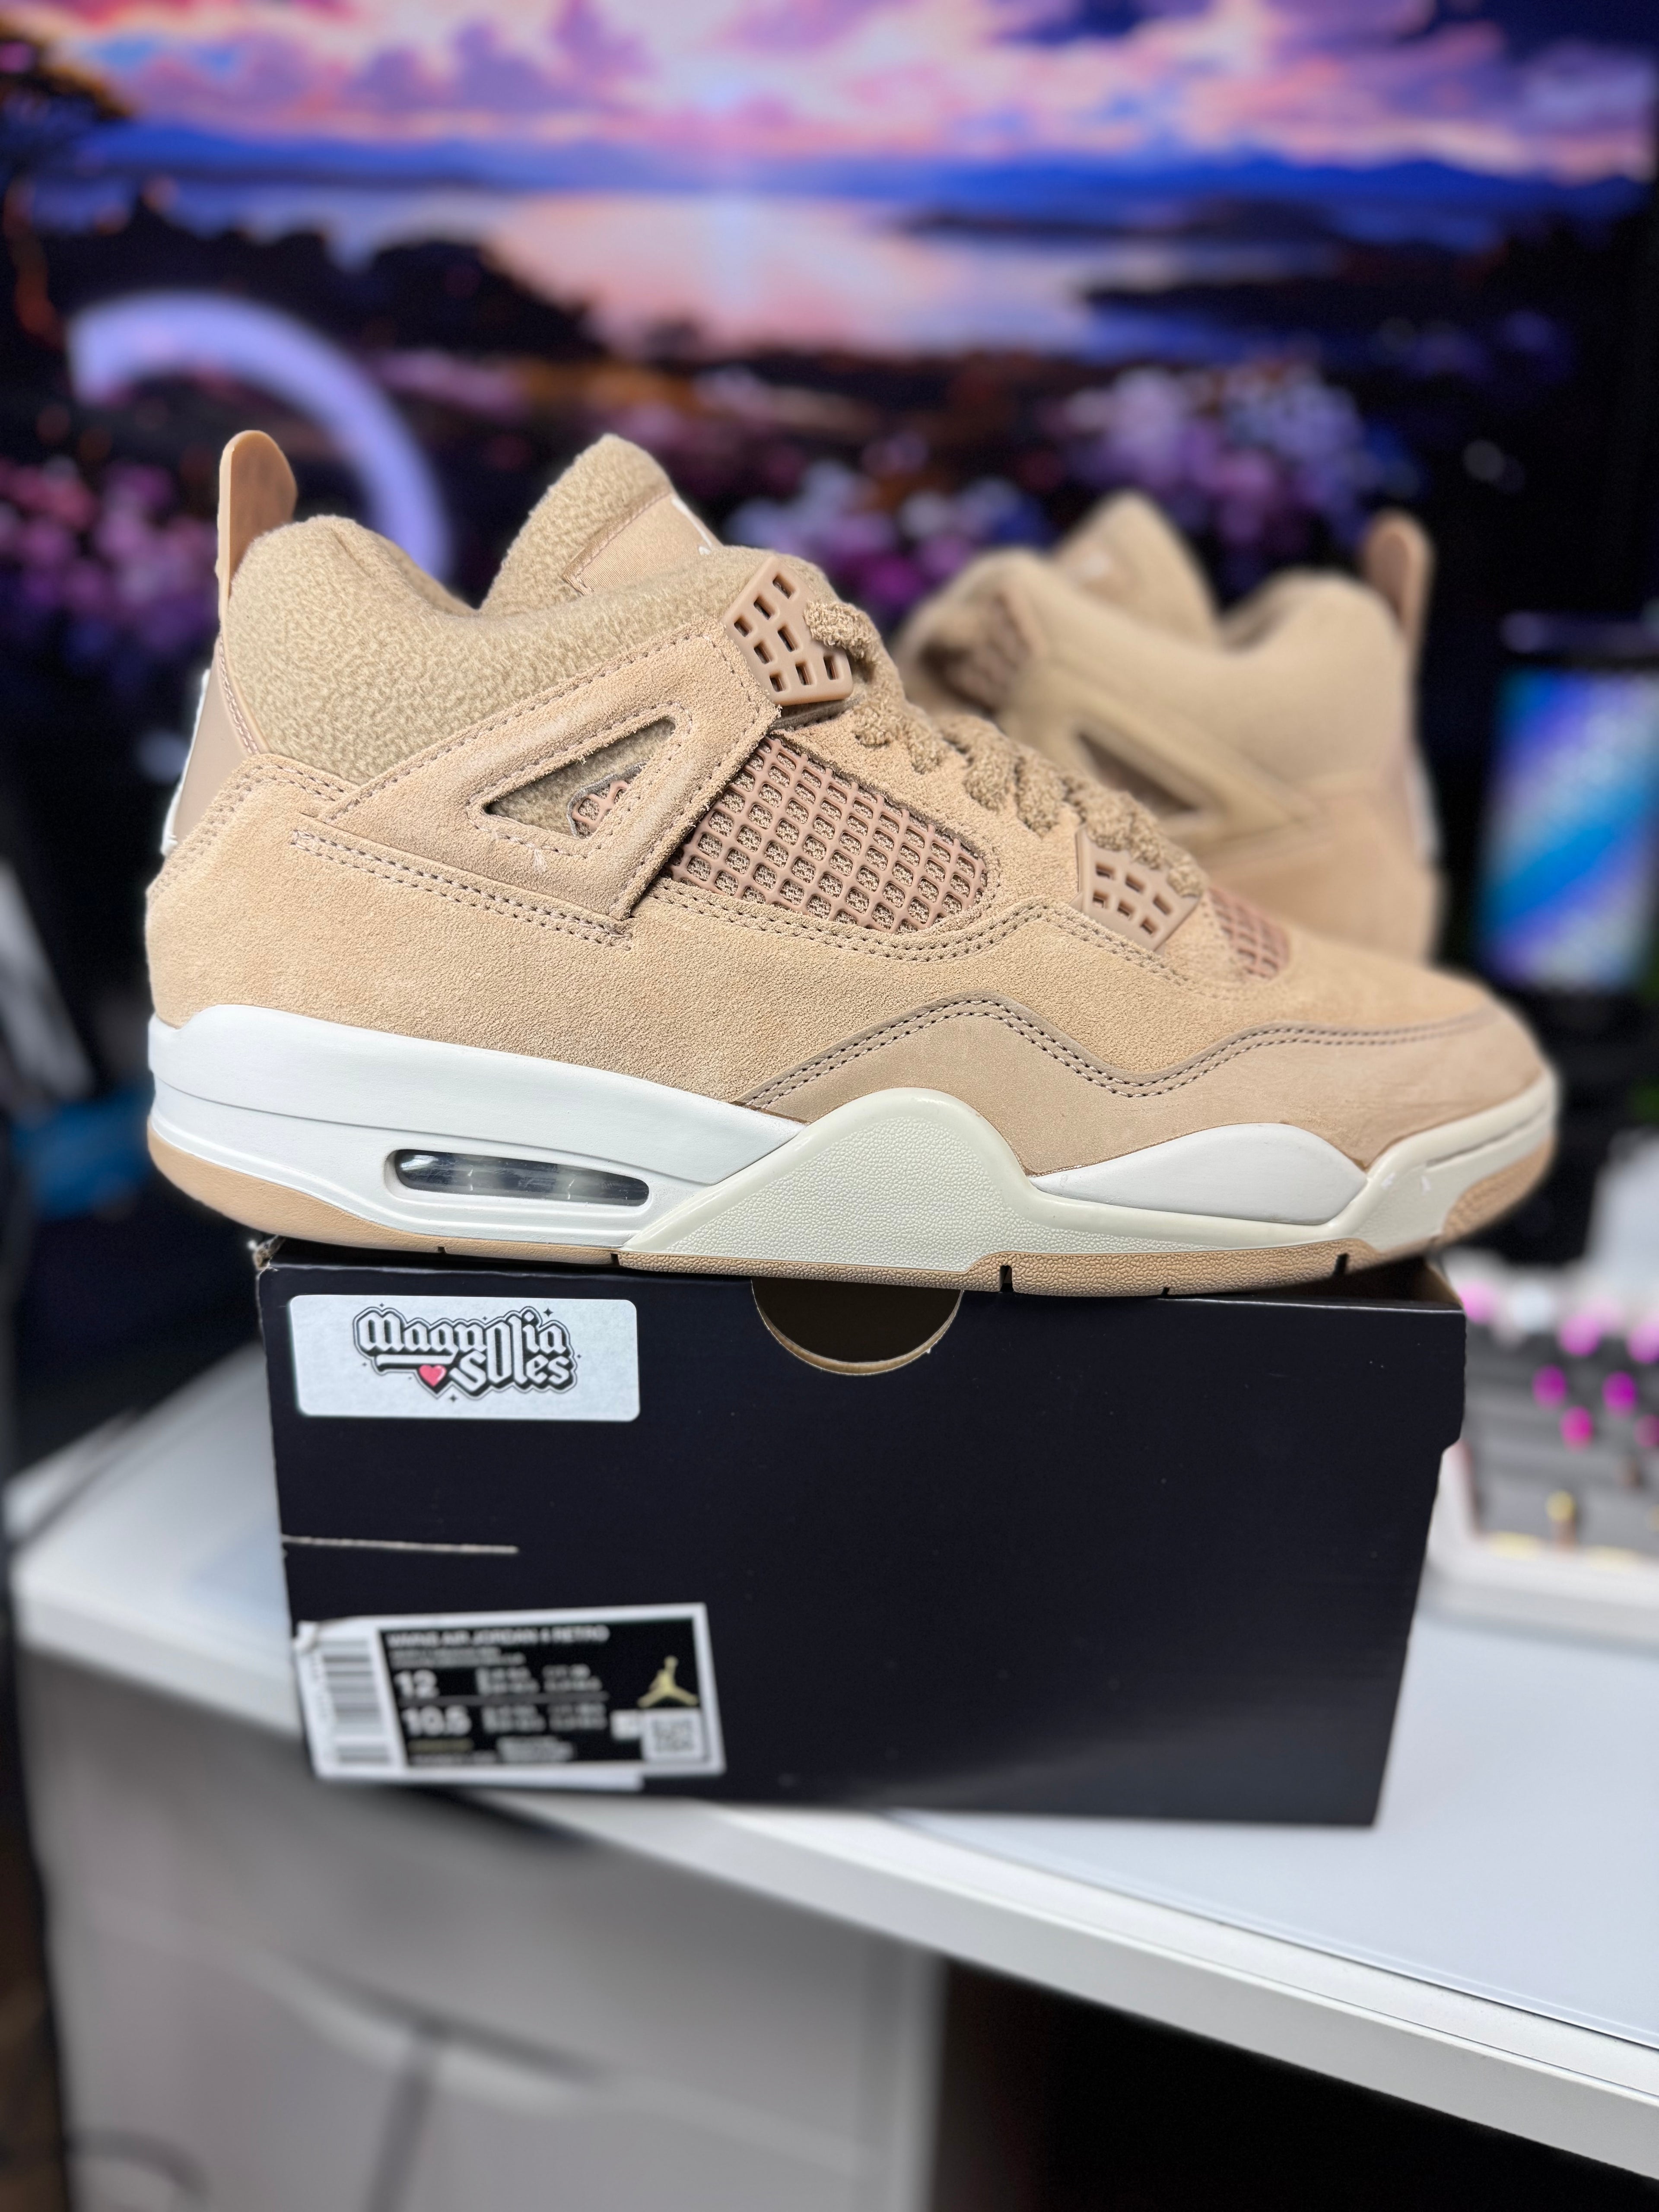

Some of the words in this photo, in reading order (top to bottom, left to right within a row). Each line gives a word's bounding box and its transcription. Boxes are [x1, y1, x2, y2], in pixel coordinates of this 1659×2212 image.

[356, 1310, 568, 1367] Magnolia
[474, 1628, 538, 1645] JORDAN
[552, 1625, 610, 1643] RETRO
[395, 1670, 438, 1698] 12
[402, 1705, 471, 1736] 10.5
